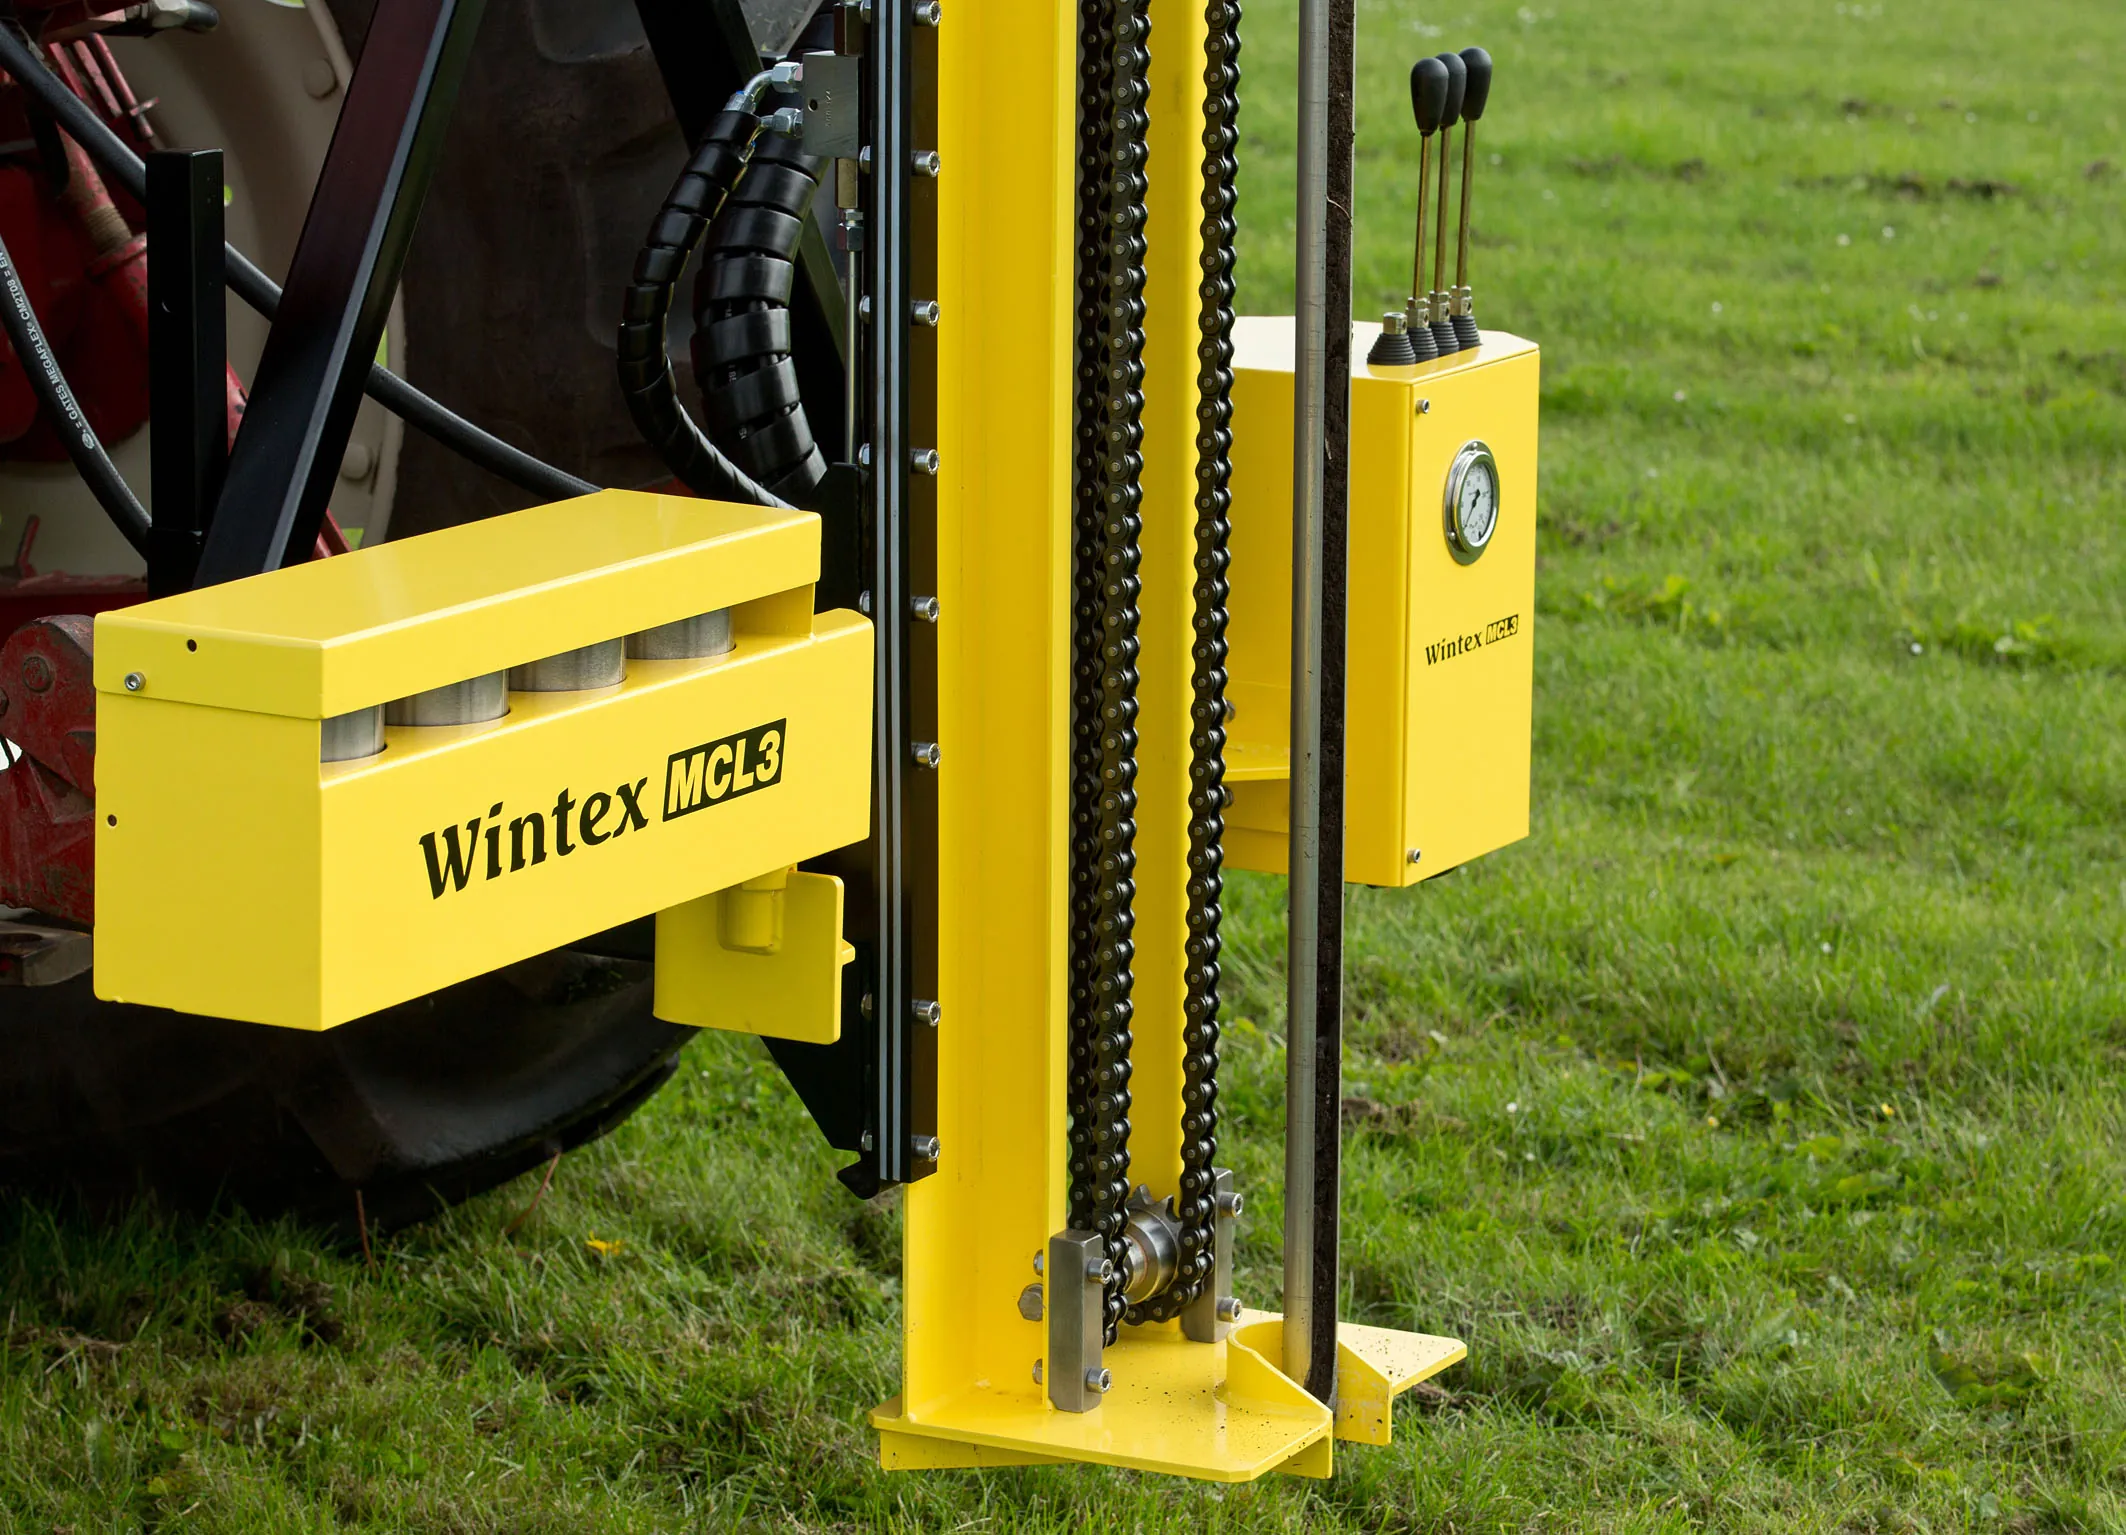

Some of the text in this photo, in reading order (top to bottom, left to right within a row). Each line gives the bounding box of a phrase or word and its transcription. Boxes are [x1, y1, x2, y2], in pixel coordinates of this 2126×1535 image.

[7, 279, 30, 320] CM2T08
[55, 385, 78, 420] GATES
[1425, 616, 1518, 666] Wintex MCL3
[418, 729, 781, 900] Wintex MCL3
